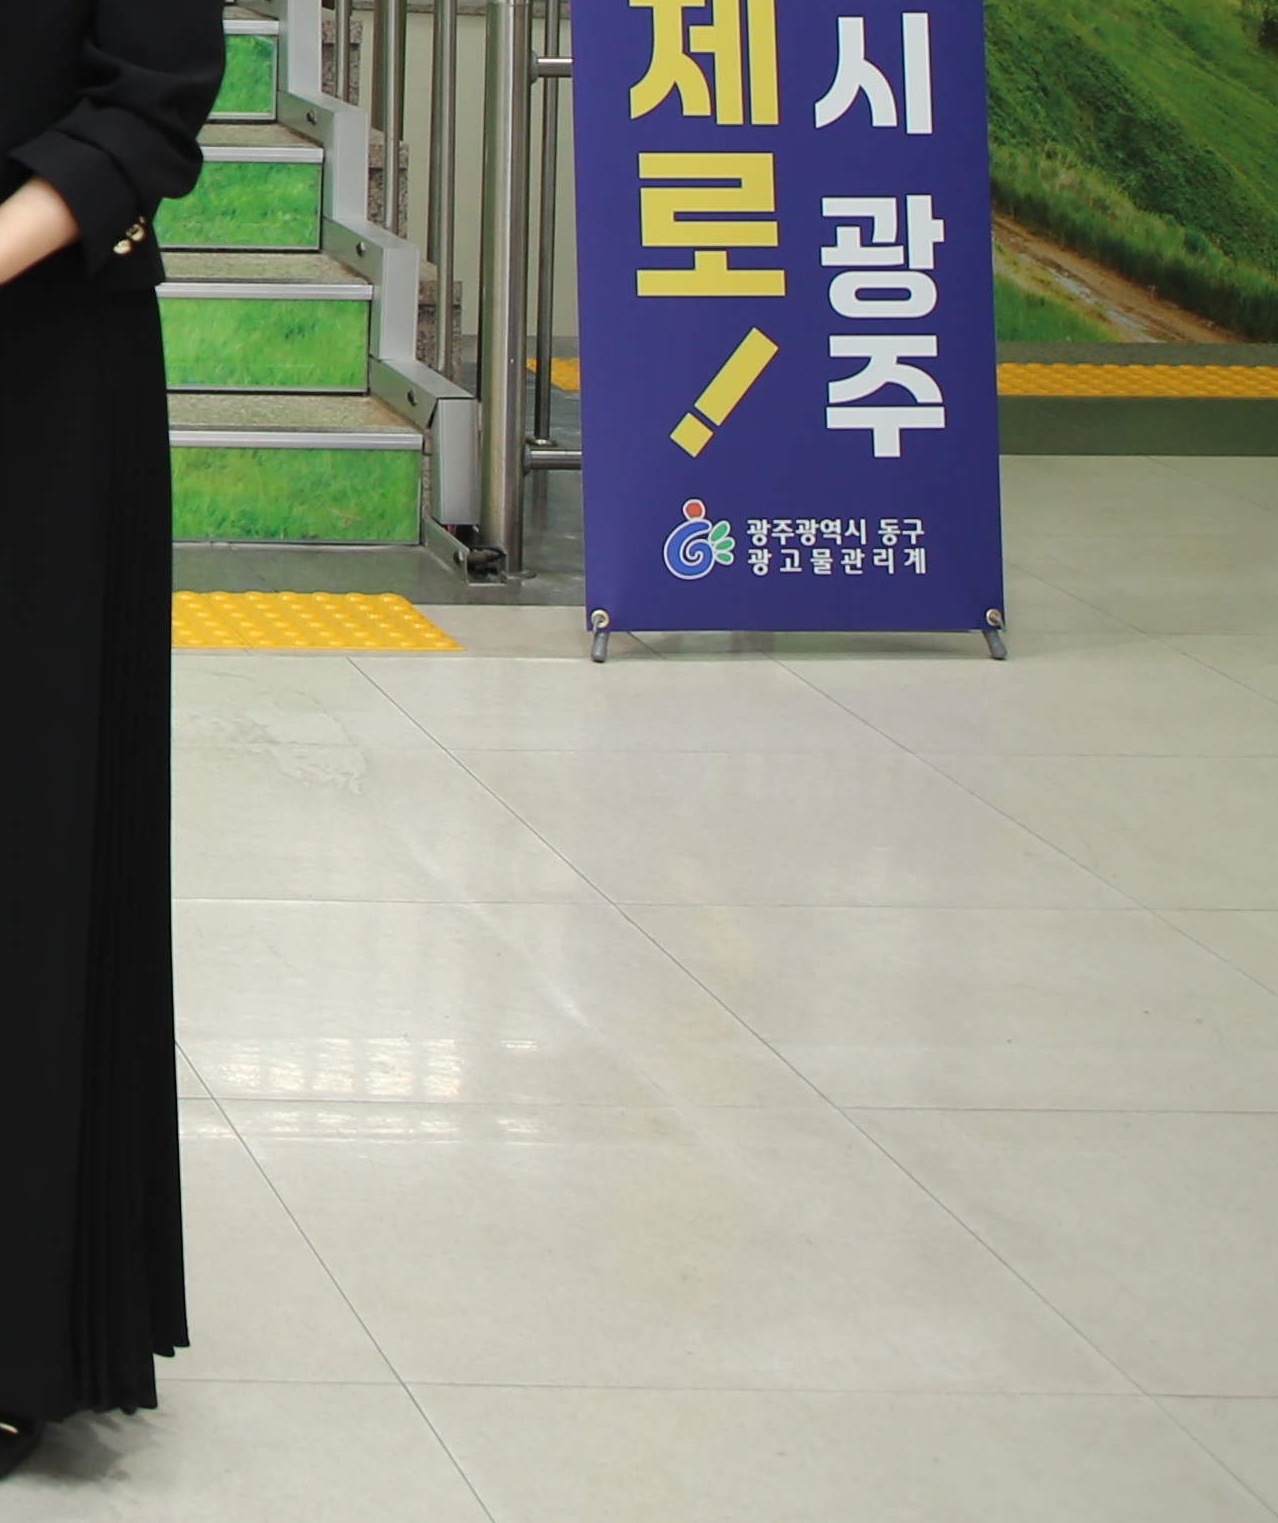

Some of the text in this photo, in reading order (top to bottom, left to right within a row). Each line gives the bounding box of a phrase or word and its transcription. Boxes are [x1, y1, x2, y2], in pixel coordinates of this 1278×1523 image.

[819, 193, 947, 459] 광주
[746, 518, 926, 546] 광주광역시 동구
[747, 548, 927, 576] 광고물관리계
